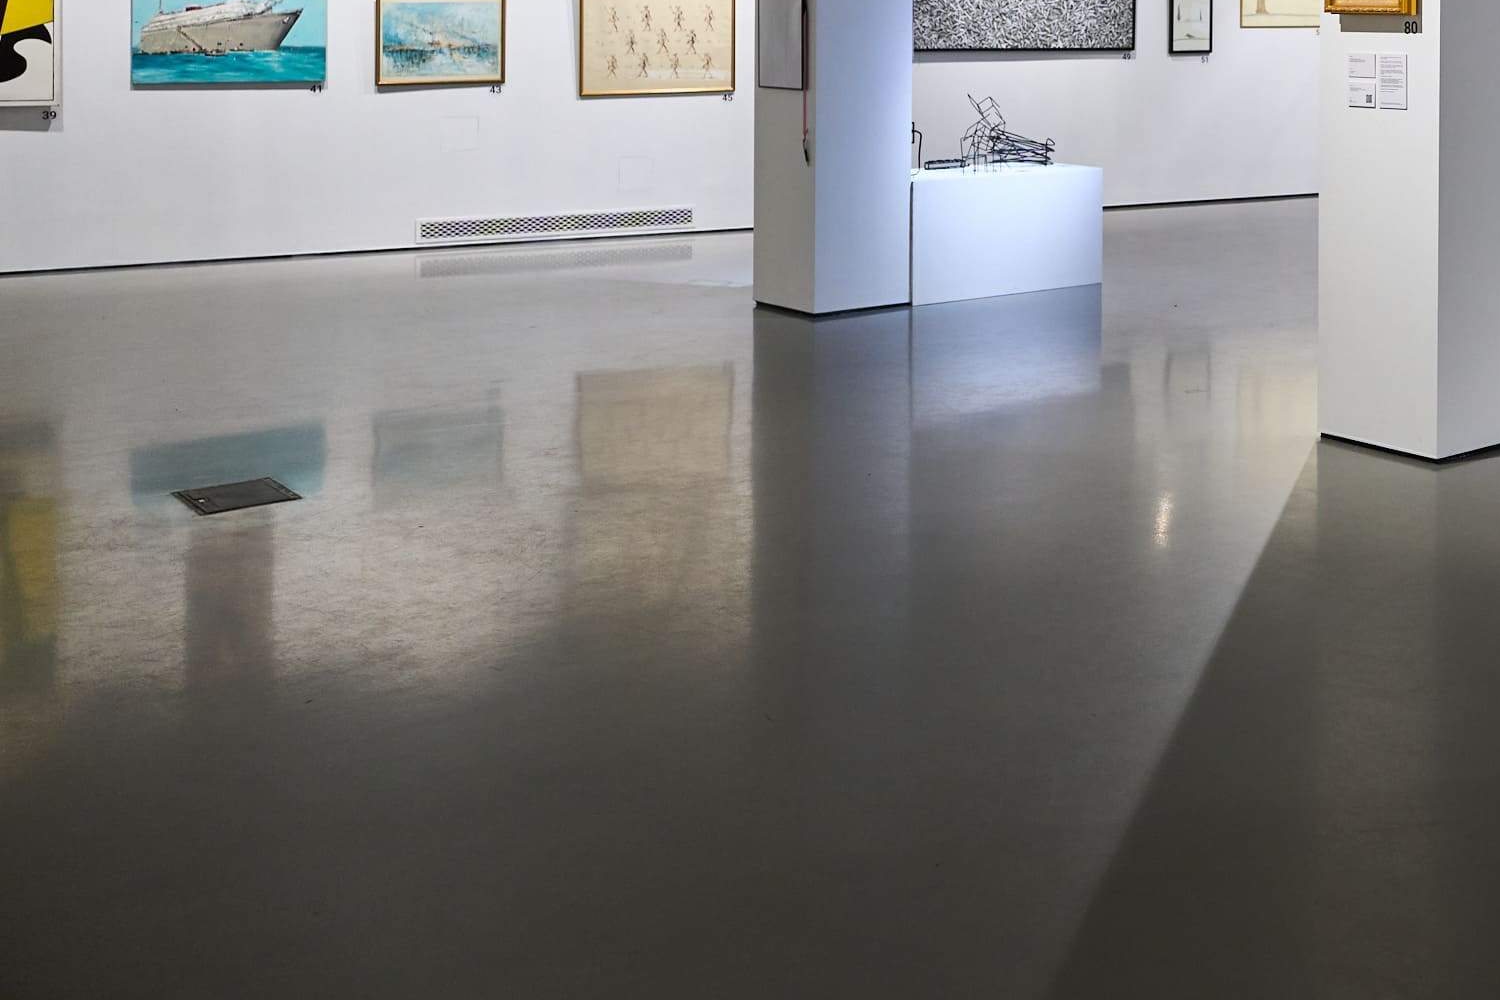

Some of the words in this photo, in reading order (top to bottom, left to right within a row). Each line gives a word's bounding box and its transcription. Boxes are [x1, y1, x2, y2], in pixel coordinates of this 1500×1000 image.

[1404, 21, 1418, 35] 80
[309, 84, 323, 93] 41
[489, 85, 502, 94] 43
[722, 94, 734, 102] 45
[42, 110, 57, 120] 39
